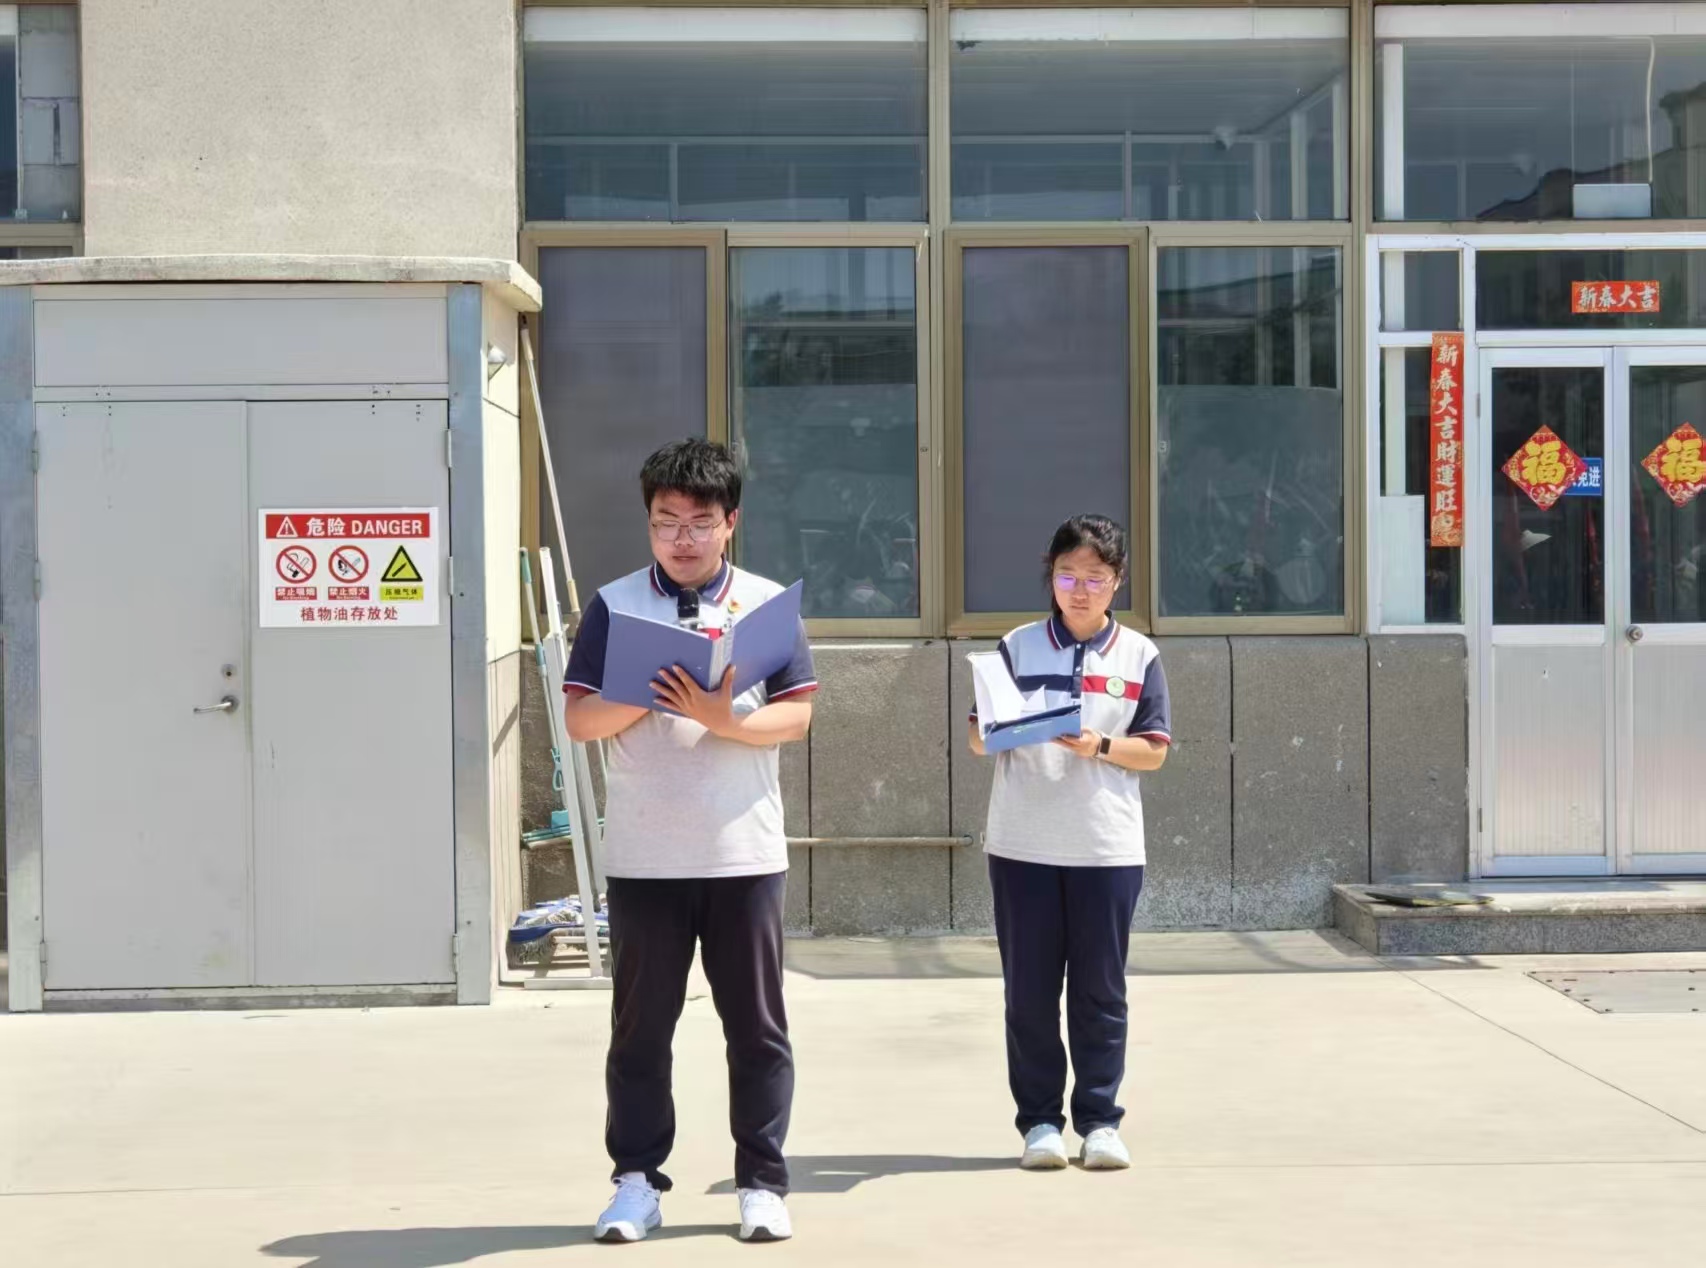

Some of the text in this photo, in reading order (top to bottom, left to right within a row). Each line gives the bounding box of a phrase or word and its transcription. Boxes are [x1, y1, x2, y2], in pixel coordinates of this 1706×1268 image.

[1578, 284, 1657, 309] 新春大吉
[1521, 440, 1567, 486] 福
[1661, 437, 1706, 483] 福
[306, 517, 423, 536] 危险 DANGER
[300, 606, 398, 621] 植物油存放处
